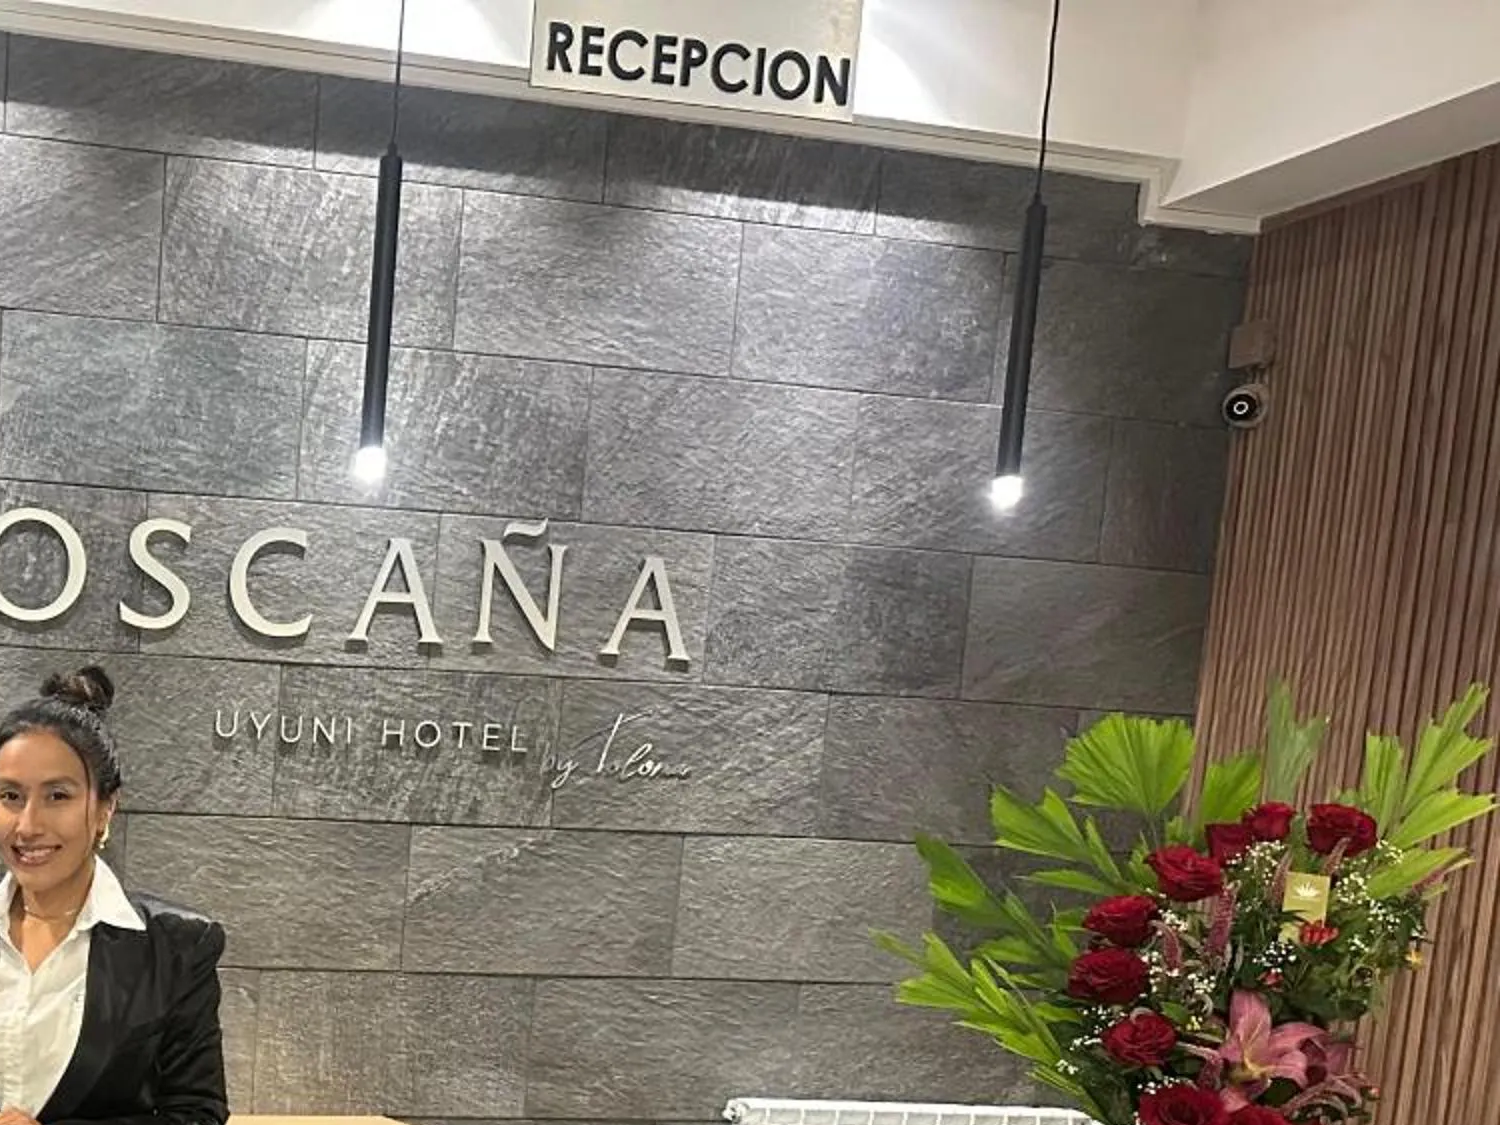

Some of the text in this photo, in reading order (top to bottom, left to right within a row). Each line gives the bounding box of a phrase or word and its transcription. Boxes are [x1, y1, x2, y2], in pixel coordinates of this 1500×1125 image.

[546, 21, 851, 106] RECEPCION
[214, 709, 352, 744] UYUNI
[382, 719, 528, 753] HOTEL
